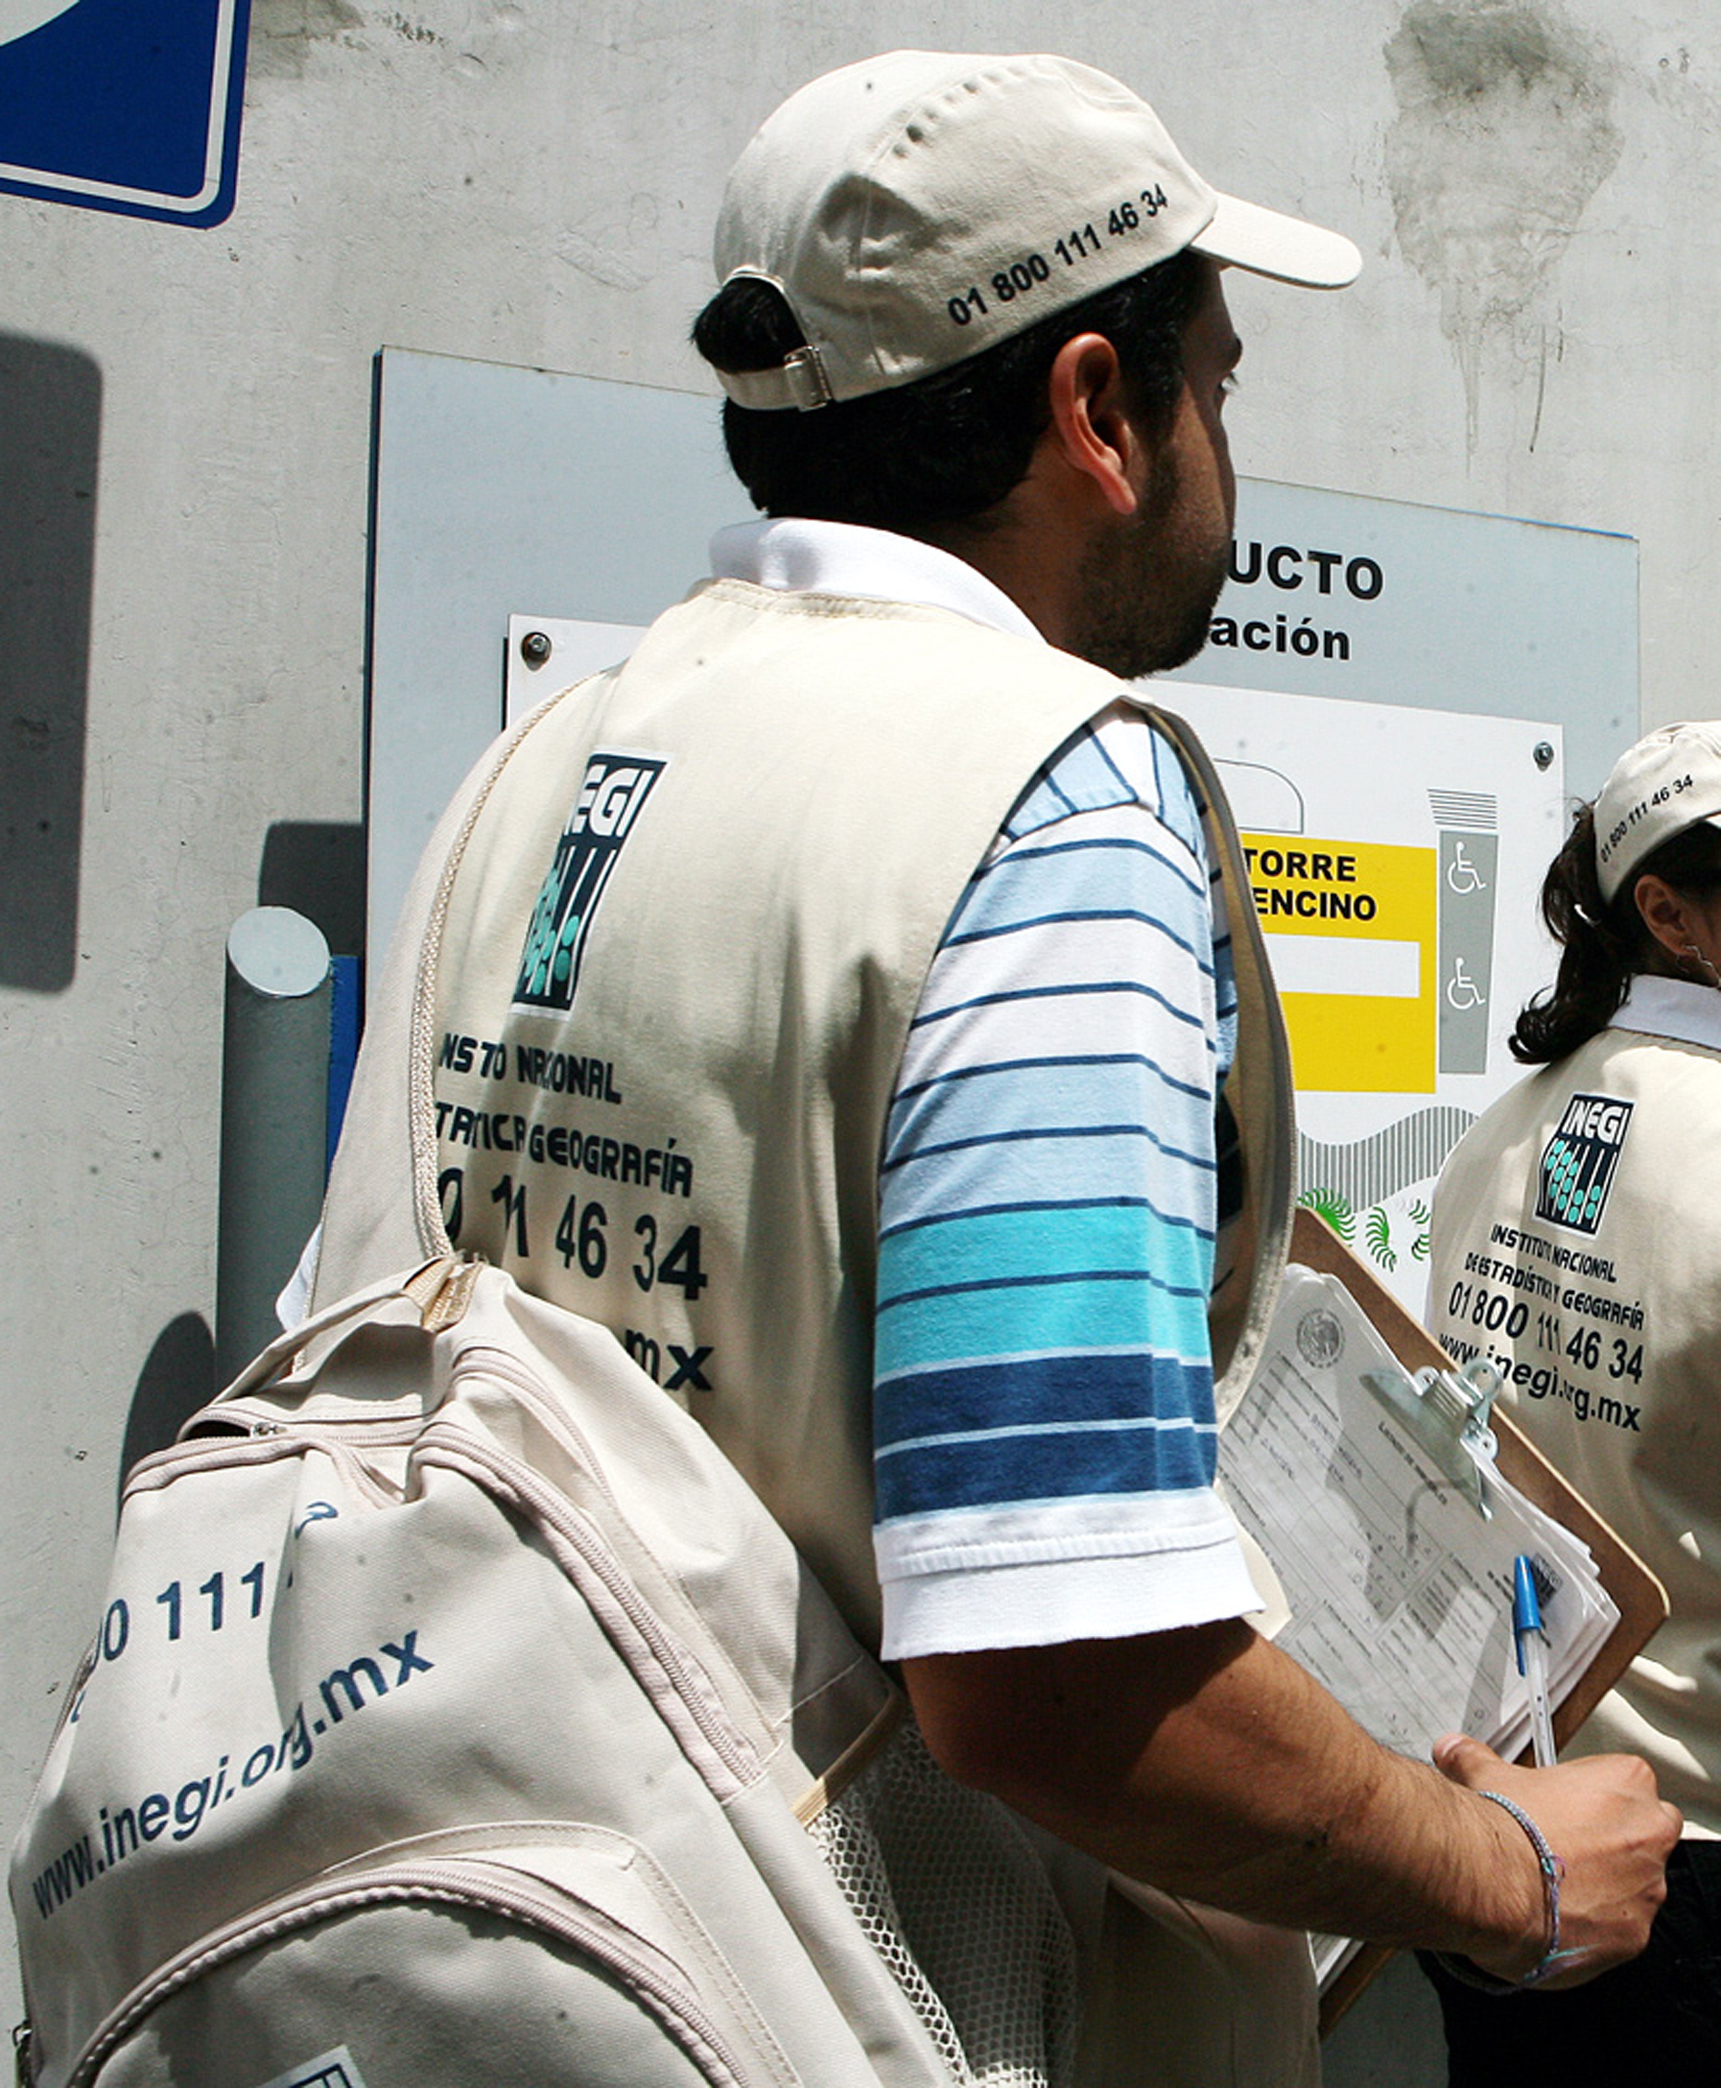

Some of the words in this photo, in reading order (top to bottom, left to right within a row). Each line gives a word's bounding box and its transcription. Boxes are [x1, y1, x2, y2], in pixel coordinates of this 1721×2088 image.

[948, 287, 988, 325] 01
[991, 253, 1049, 301] 800
[1055, 223, 1101, 266] 111
[1108, 202, 1139, 236] 46
[1141, 183, 1168, 217] 34
[1228, 540, 1383, 600] UCTO
[1210, 614, 1350, 660] ación
[568, 764, 655, 837] EGI
[1629, 802, 1648, 825] 111
[1651, 787, 1670, 806] 46
[1673, 774, 1693, 794] 34
[1243, 848, 1356, 882] TORRE
[1253, 887, 1376, 921] ENCINO
[1562, 1100, 1630, 1147] INEGI
[555, 1194, 607, 1279] 46
[632, 1214, 708, 1300] 34
[625, 1329, 714, 1391] mx
[1449, 1281, 1473, 1319] 01
[1472, 1289, 1529, 1339] 800
[1537, 1312, 1561, 1355] 111
[1566, 1327, 1601, 1370] 46
[1609, 1338, 1643, 1384] 34
[157, 1562, 265, 1641] 111
